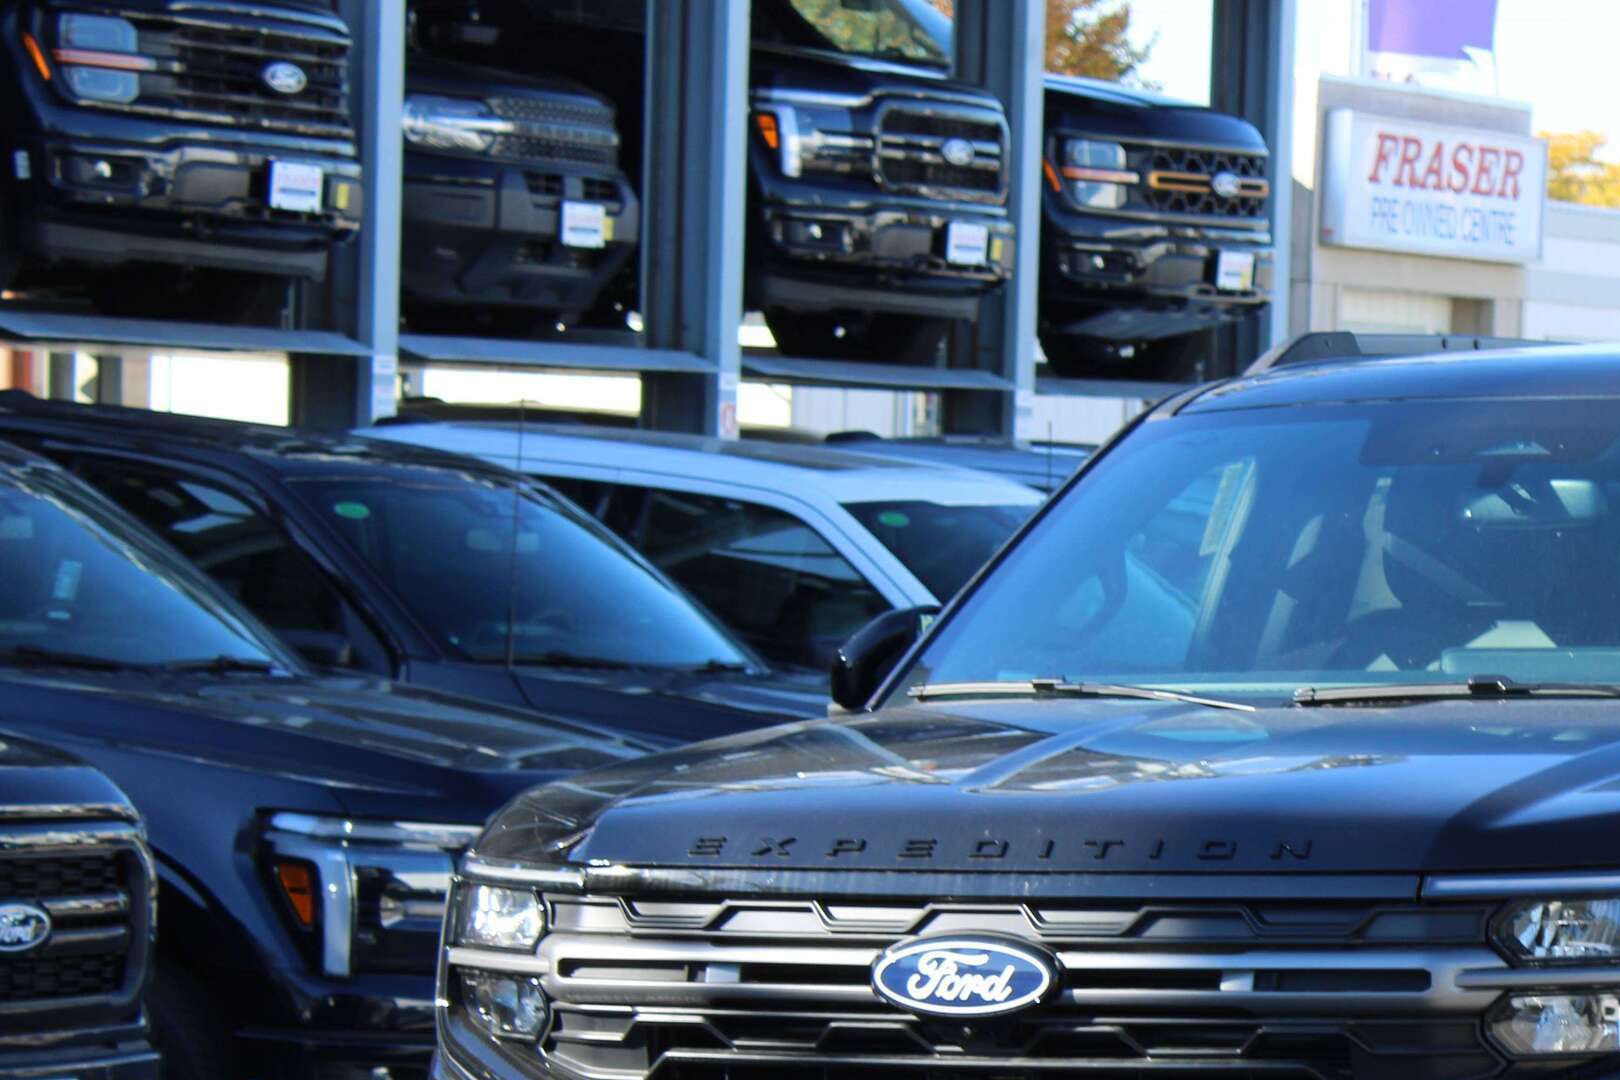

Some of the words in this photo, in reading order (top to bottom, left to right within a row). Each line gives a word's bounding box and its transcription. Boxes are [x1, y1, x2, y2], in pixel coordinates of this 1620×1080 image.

[1368, 132, 1525, 200] FRASER
[688, 836, 1313, 861] EXPEDITION
[907, 950, 1016, 1001] Ford
